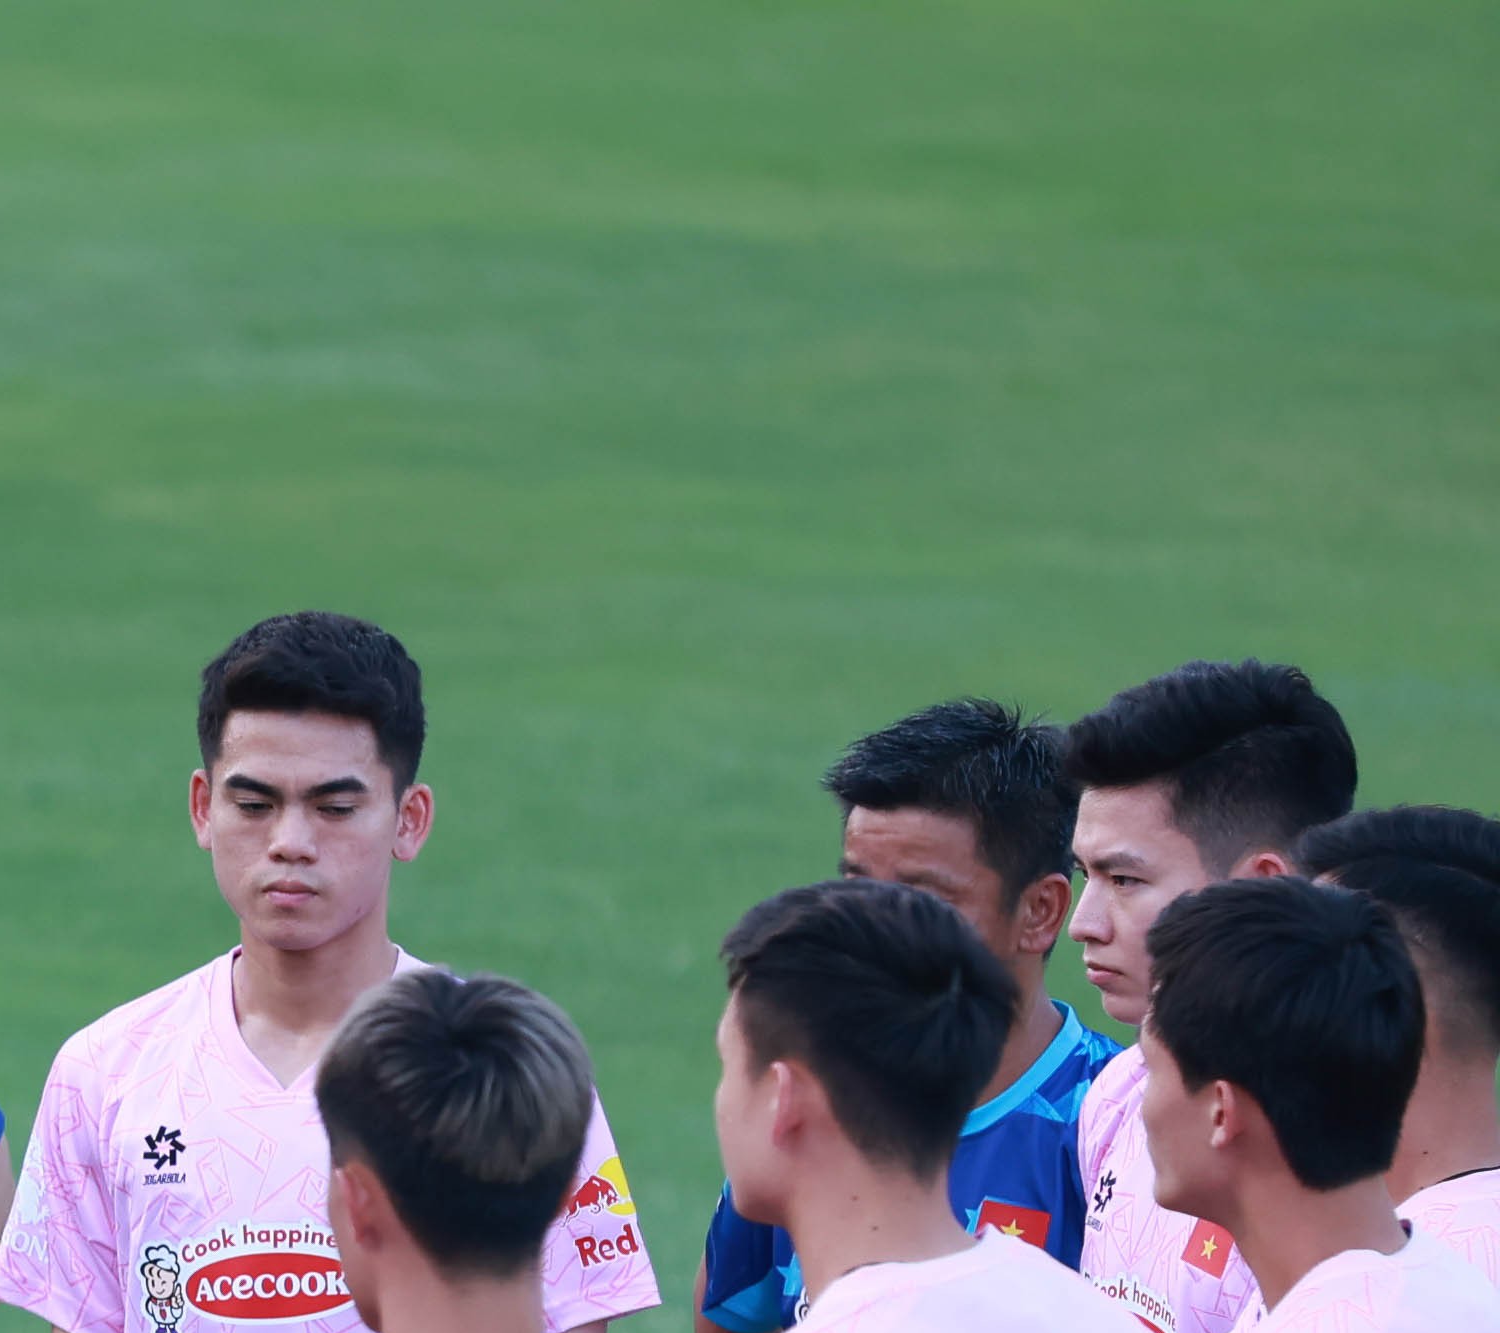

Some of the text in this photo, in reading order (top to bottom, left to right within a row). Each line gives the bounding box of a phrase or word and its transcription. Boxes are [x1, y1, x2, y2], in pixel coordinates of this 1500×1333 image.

[181, 1223, 339, 1263] Cook happine
[574, 1223, 639, 1268] Red
